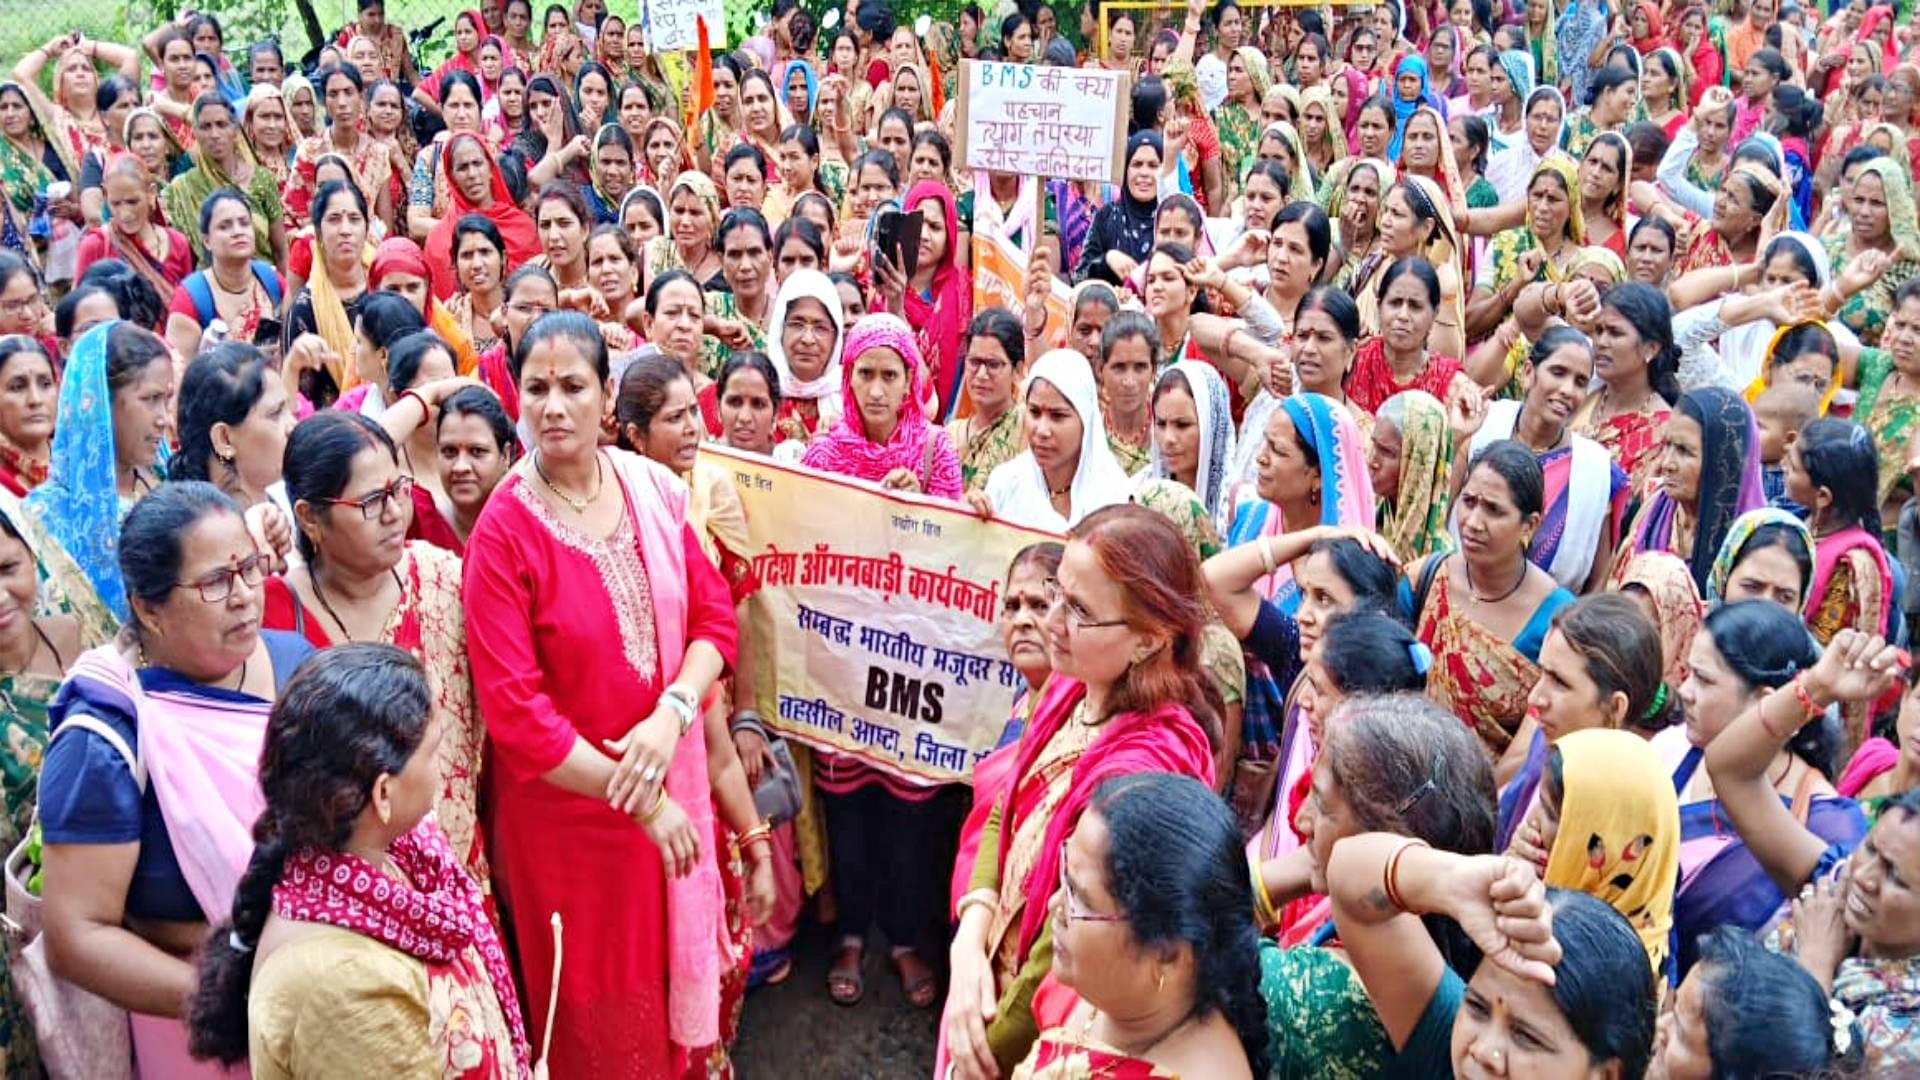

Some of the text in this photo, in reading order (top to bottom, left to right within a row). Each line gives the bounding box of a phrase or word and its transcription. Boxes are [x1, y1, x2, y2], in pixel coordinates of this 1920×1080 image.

[982, 63, 1114, 100] BMS की क्या
[1003, 101, 1067, 122] पहचान
[908, 564, 999, 623] कार्यकर्ता
[860, 626, 927, 667] भारतीय
[865, 665, 945, 724] BMS
[779, 695, 845, 734] तहसील
[915, 732, 968, 772] जिला
